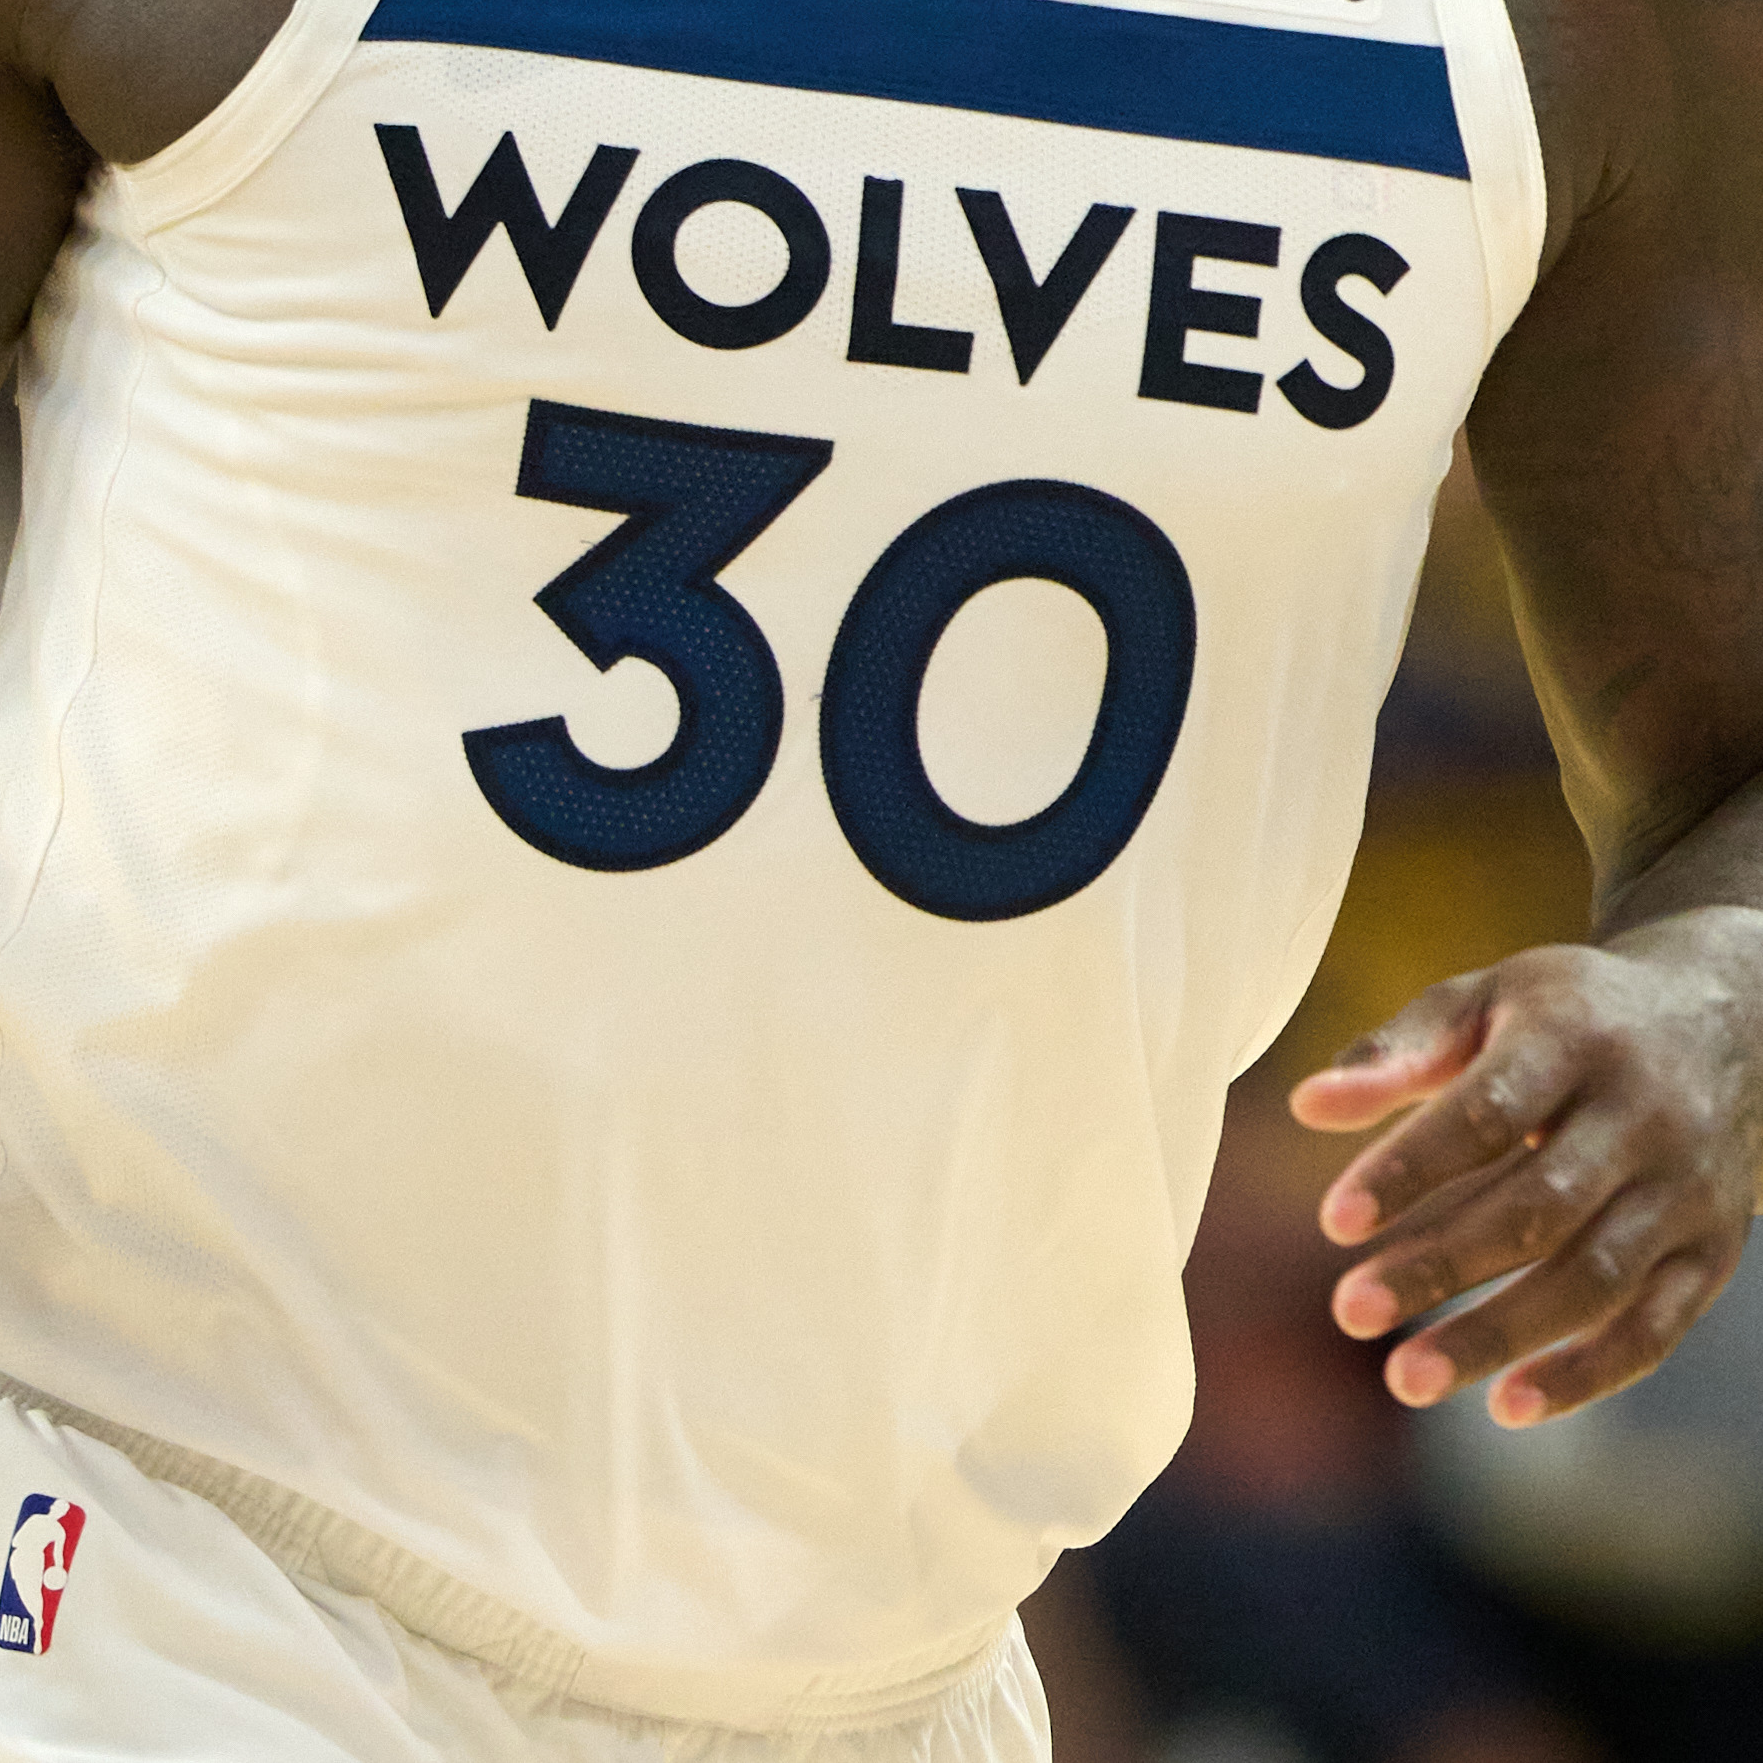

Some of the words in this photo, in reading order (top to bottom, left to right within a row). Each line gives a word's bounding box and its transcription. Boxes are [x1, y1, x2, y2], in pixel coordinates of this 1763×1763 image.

[373, 122, 1411, 431] WOLVES
[461, 398, 1198, 923] 30
[0, 1613, 30, 1646] NBA
